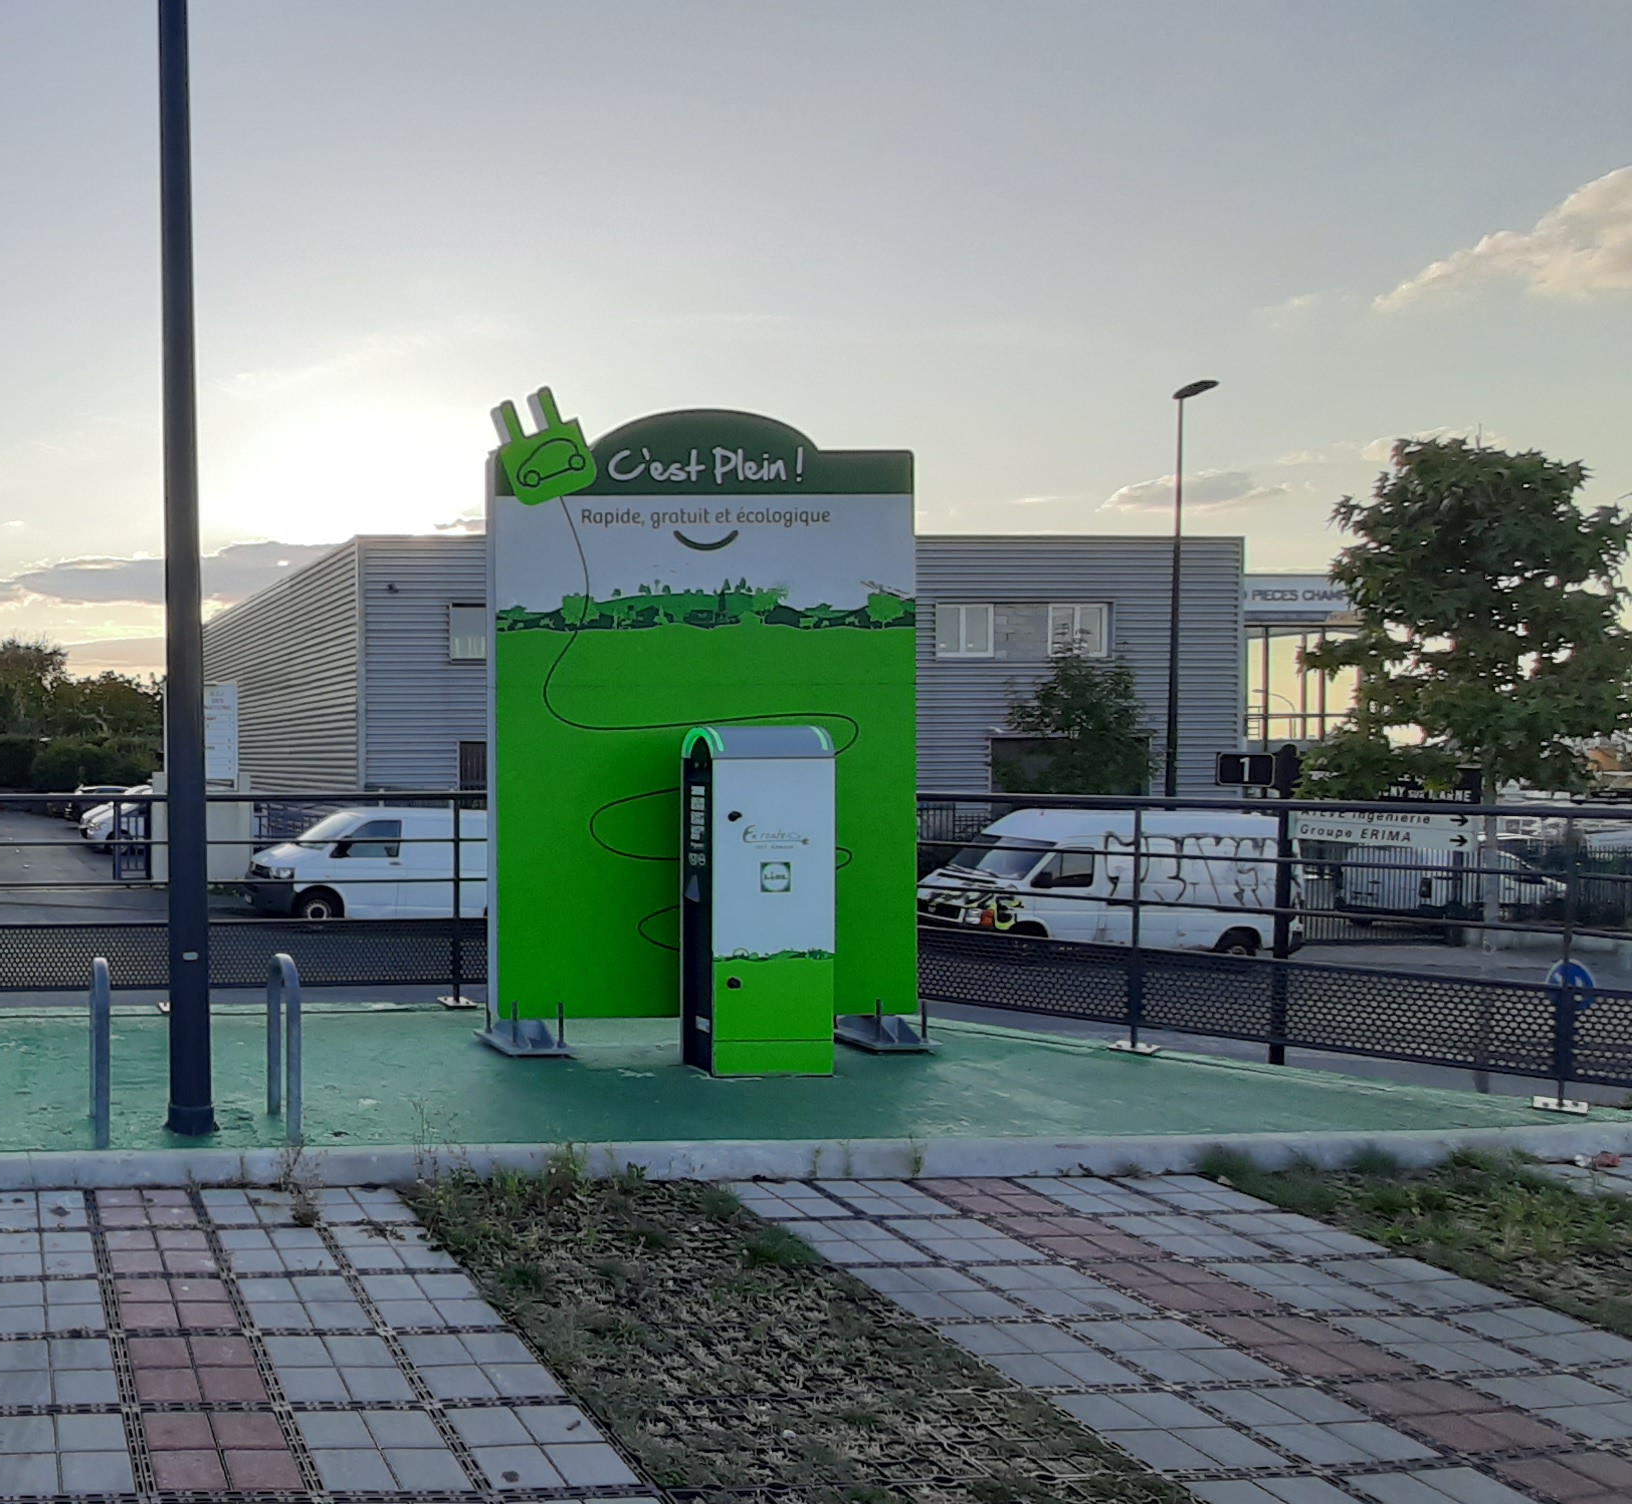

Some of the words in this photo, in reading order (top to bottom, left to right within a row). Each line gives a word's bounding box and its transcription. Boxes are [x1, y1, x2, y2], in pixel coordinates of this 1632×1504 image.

[607, 448, 706, 482] C'est
[713, 447, 787, 484] Plein
[796, 446, 804, 482] !
[580, 507, 646, 527] Rapide,
[650, 507, 711, 529] gratuit
[715, 507, 733, 524] et
[736, 505, 831, 529] écologique
[1252, 589, 1299, 601] PIECES
[1239, 756, 1250, 782] 1
[1300, 824, 1352, 839] Groupe
[1360, 828, 1412, 842] ERIMA
